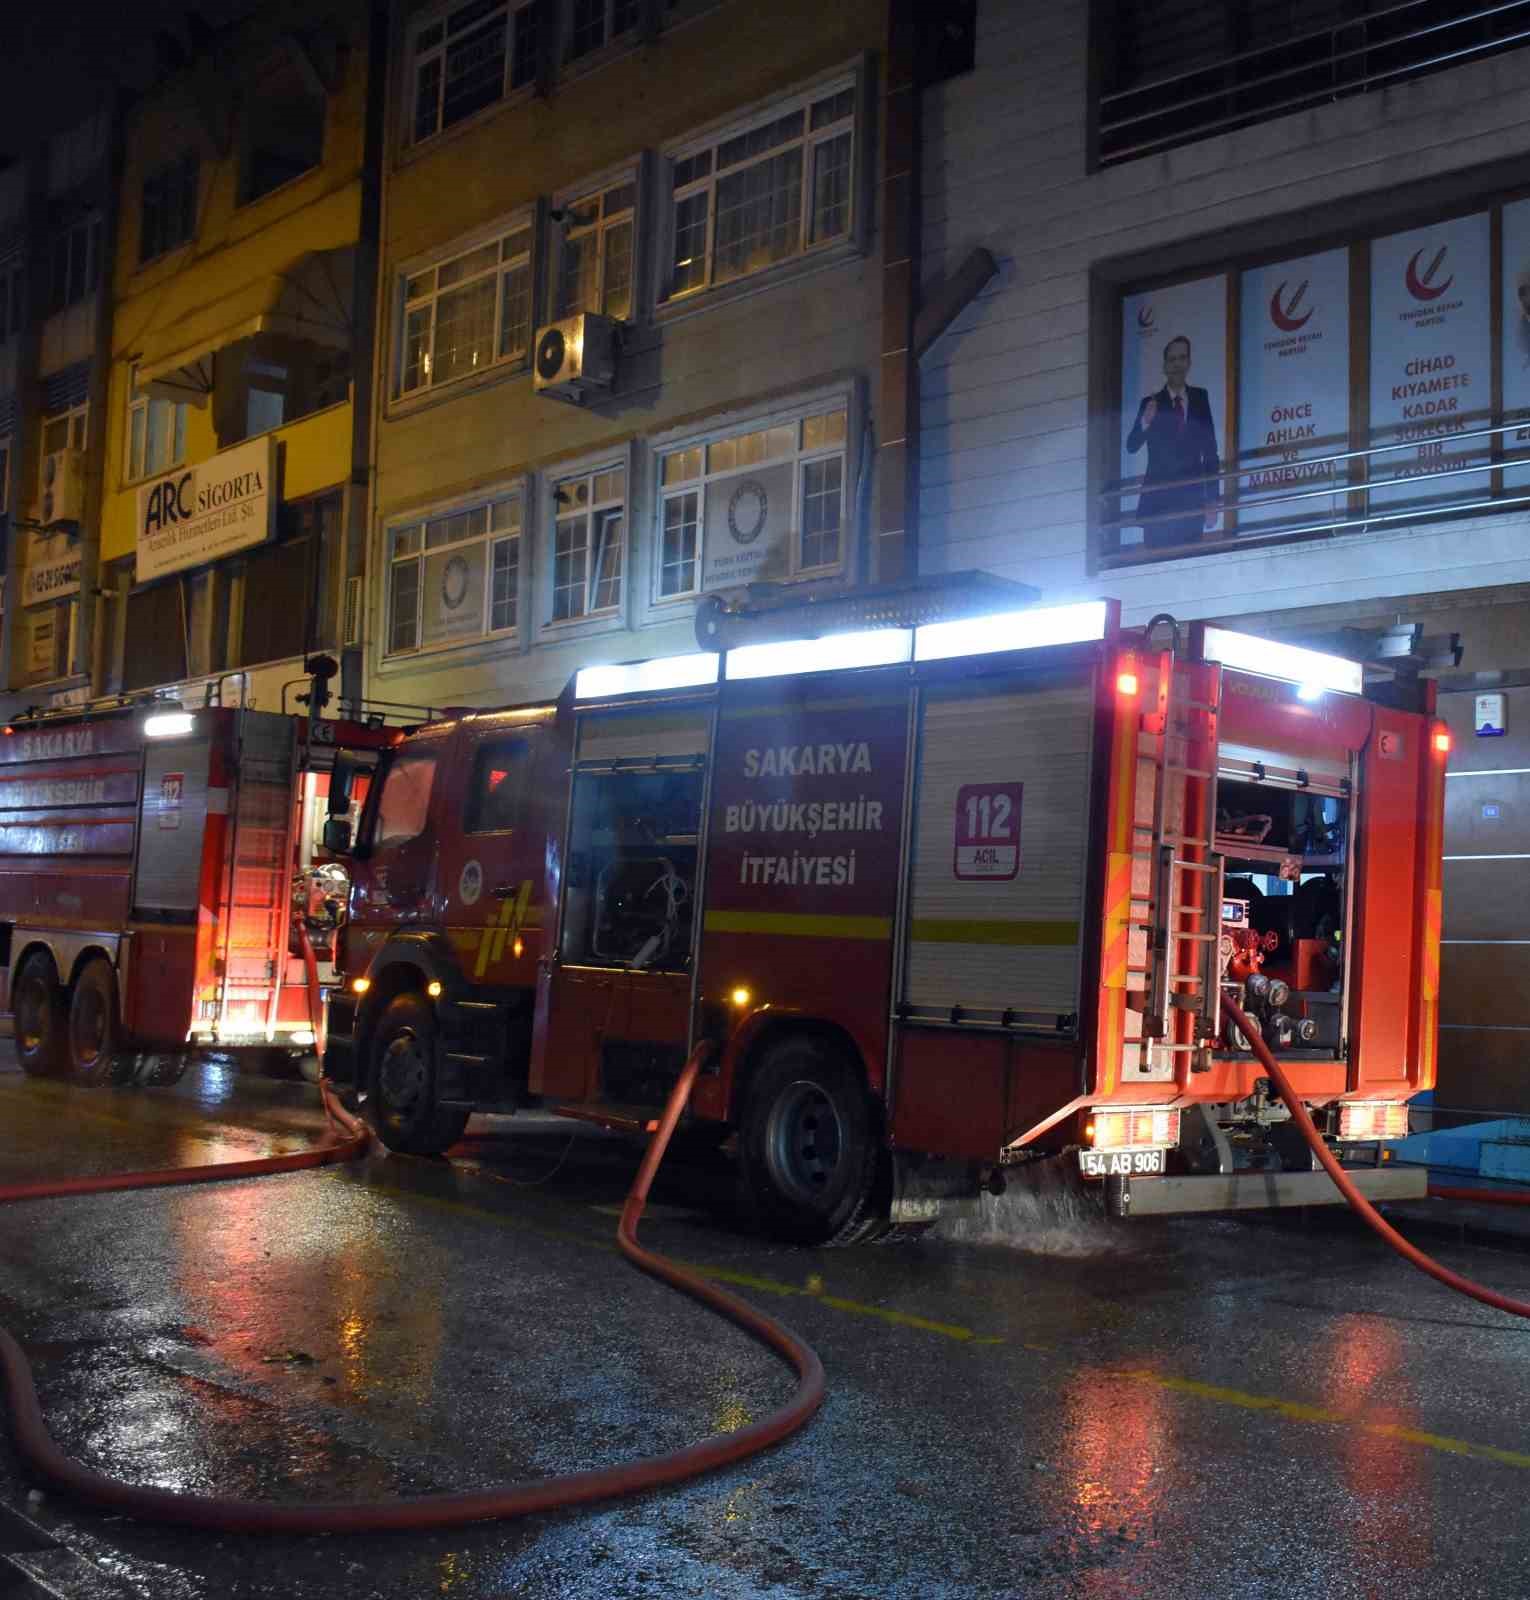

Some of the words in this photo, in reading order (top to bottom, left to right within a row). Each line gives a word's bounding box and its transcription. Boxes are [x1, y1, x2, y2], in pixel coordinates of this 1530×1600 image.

[1405, 355, 1456, 377] CİHAD
[1392, 373, 1471, 400] KIYAMETE
[1271, 403, 1312, 424] ÖNCE
[1403, 397, 1458, 419] KADAR
[1266, 424, 1318, 445] AHLAK
[145, 471, 193, 535] ARC
[198, 471, 263, 513] SİGORTA
[23, 729, 94, 759] SAKARYA
[743, 742, 872, 778] SAKARYA
[724, 794, 884, 838] BÜYÜKŞEHİR
[965, 793, 1012, 840] 112
[739, 848, 856, 886] İTFAİYESİ
[1087, 1155, 1107, 1176] 54
[1110, 1152, 1132, 1174] AB
[1133, 1150, 1160, 1173] 906
